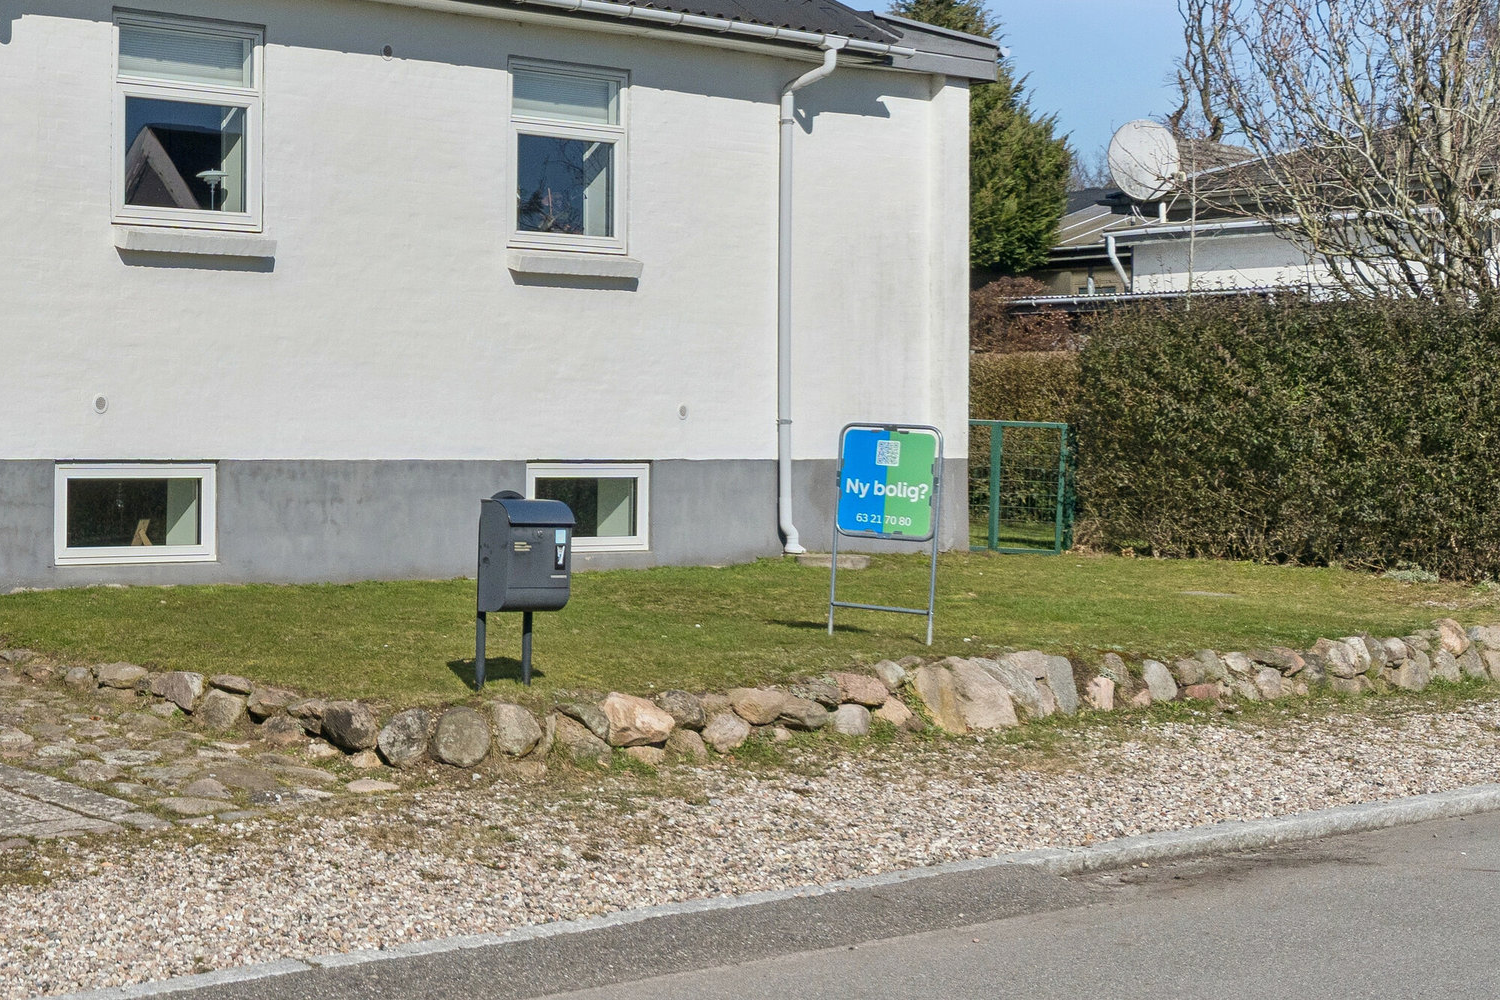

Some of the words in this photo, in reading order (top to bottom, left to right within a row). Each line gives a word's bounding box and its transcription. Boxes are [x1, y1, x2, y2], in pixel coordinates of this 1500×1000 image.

[845, 478, 870, 498] Ny
[873, 480, 929, 503] bolig?
[856, 512, 869, 523] 63
[870, 513, 882, 524] 21
[885, 514, 897, 525] 70
[898, 516, 912, 527] 80
